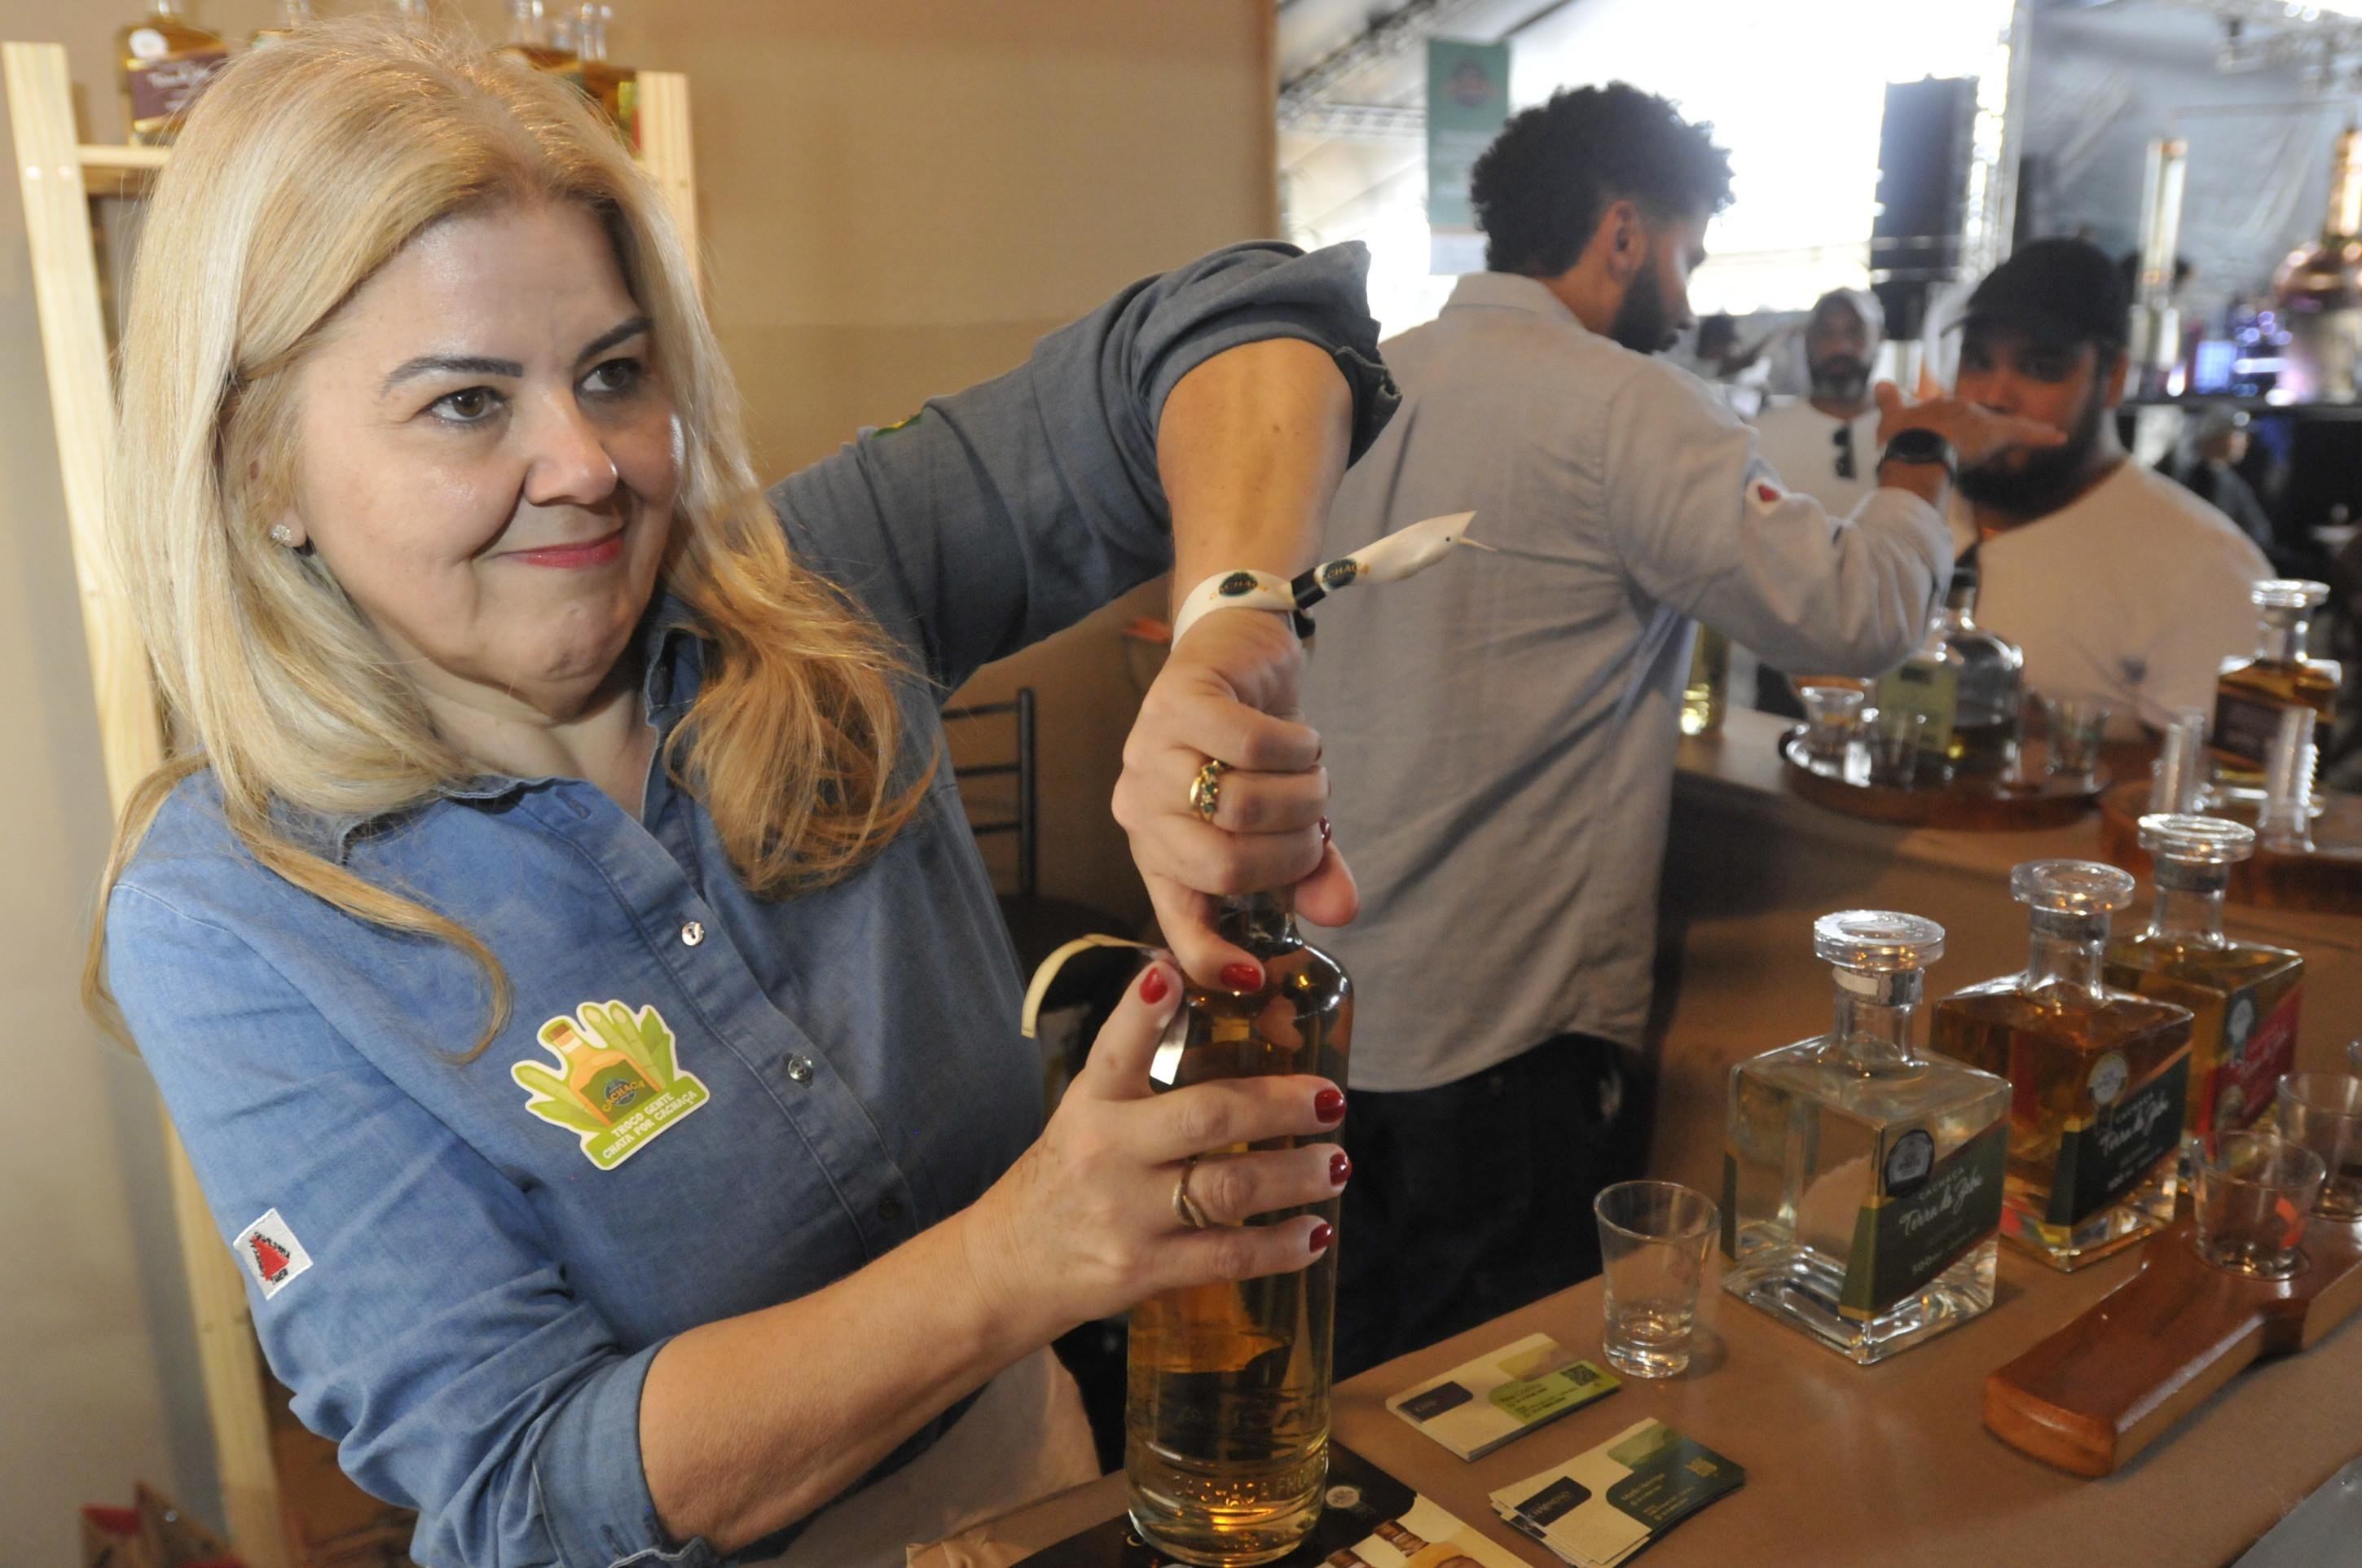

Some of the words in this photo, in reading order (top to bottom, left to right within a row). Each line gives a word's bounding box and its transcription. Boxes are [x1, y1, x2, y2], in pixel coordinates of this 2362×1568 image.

[603, 1131, 635, 1158] CHATA
[634, 1120, 655, 1136] POR
[655, 1090, 697, 1121] CACHAÇA
[611, 1113, 644, 1138] TROCO
[644, 1091, 675, 1115] GENTE
